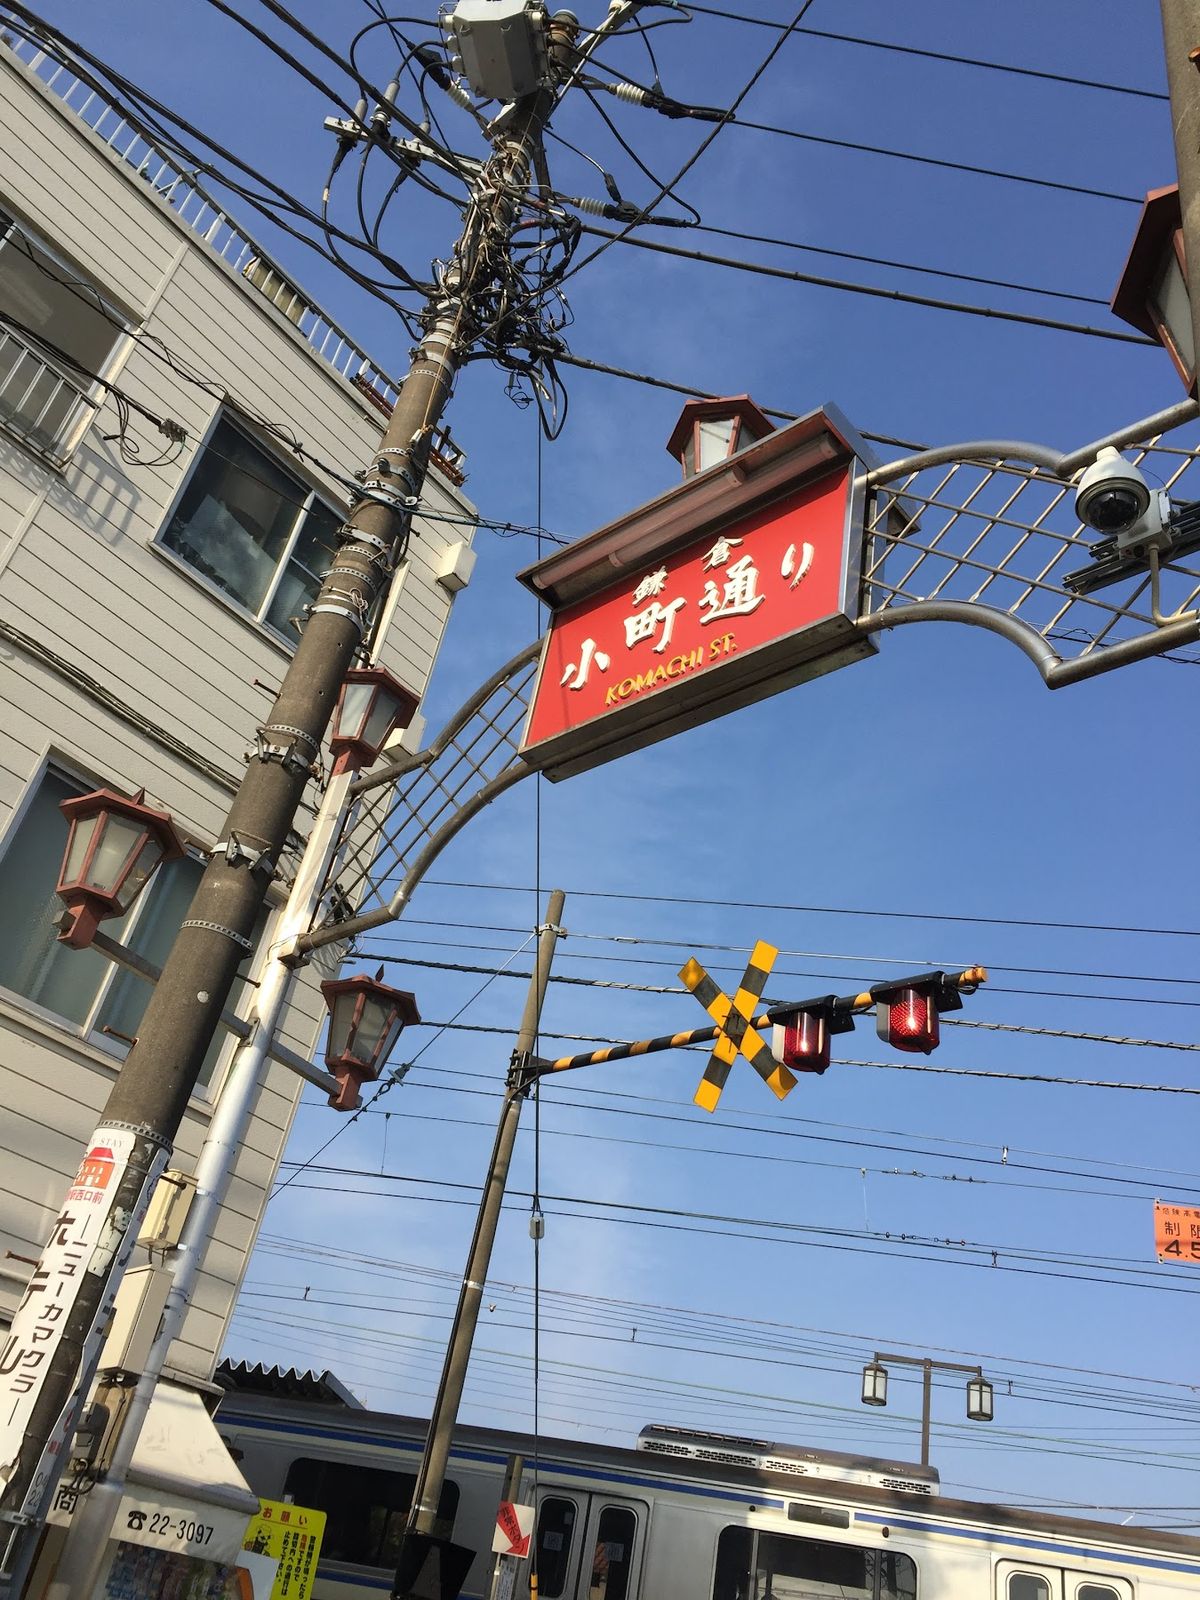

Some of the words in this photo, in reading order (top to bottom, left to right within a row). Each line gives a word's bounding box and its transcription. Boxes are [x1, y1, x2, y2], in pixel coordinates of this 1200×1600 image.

[632, 536, 744, 605] 鎌倉
[560, 541, 815, 690] 小町通り
[604, 646, 704, 706] KOMACHI
[708, 632, 739, 661] ST.
[148, 1513, 214, 1546] 22-3097
[262, 1507, 308, 1525] お願い
